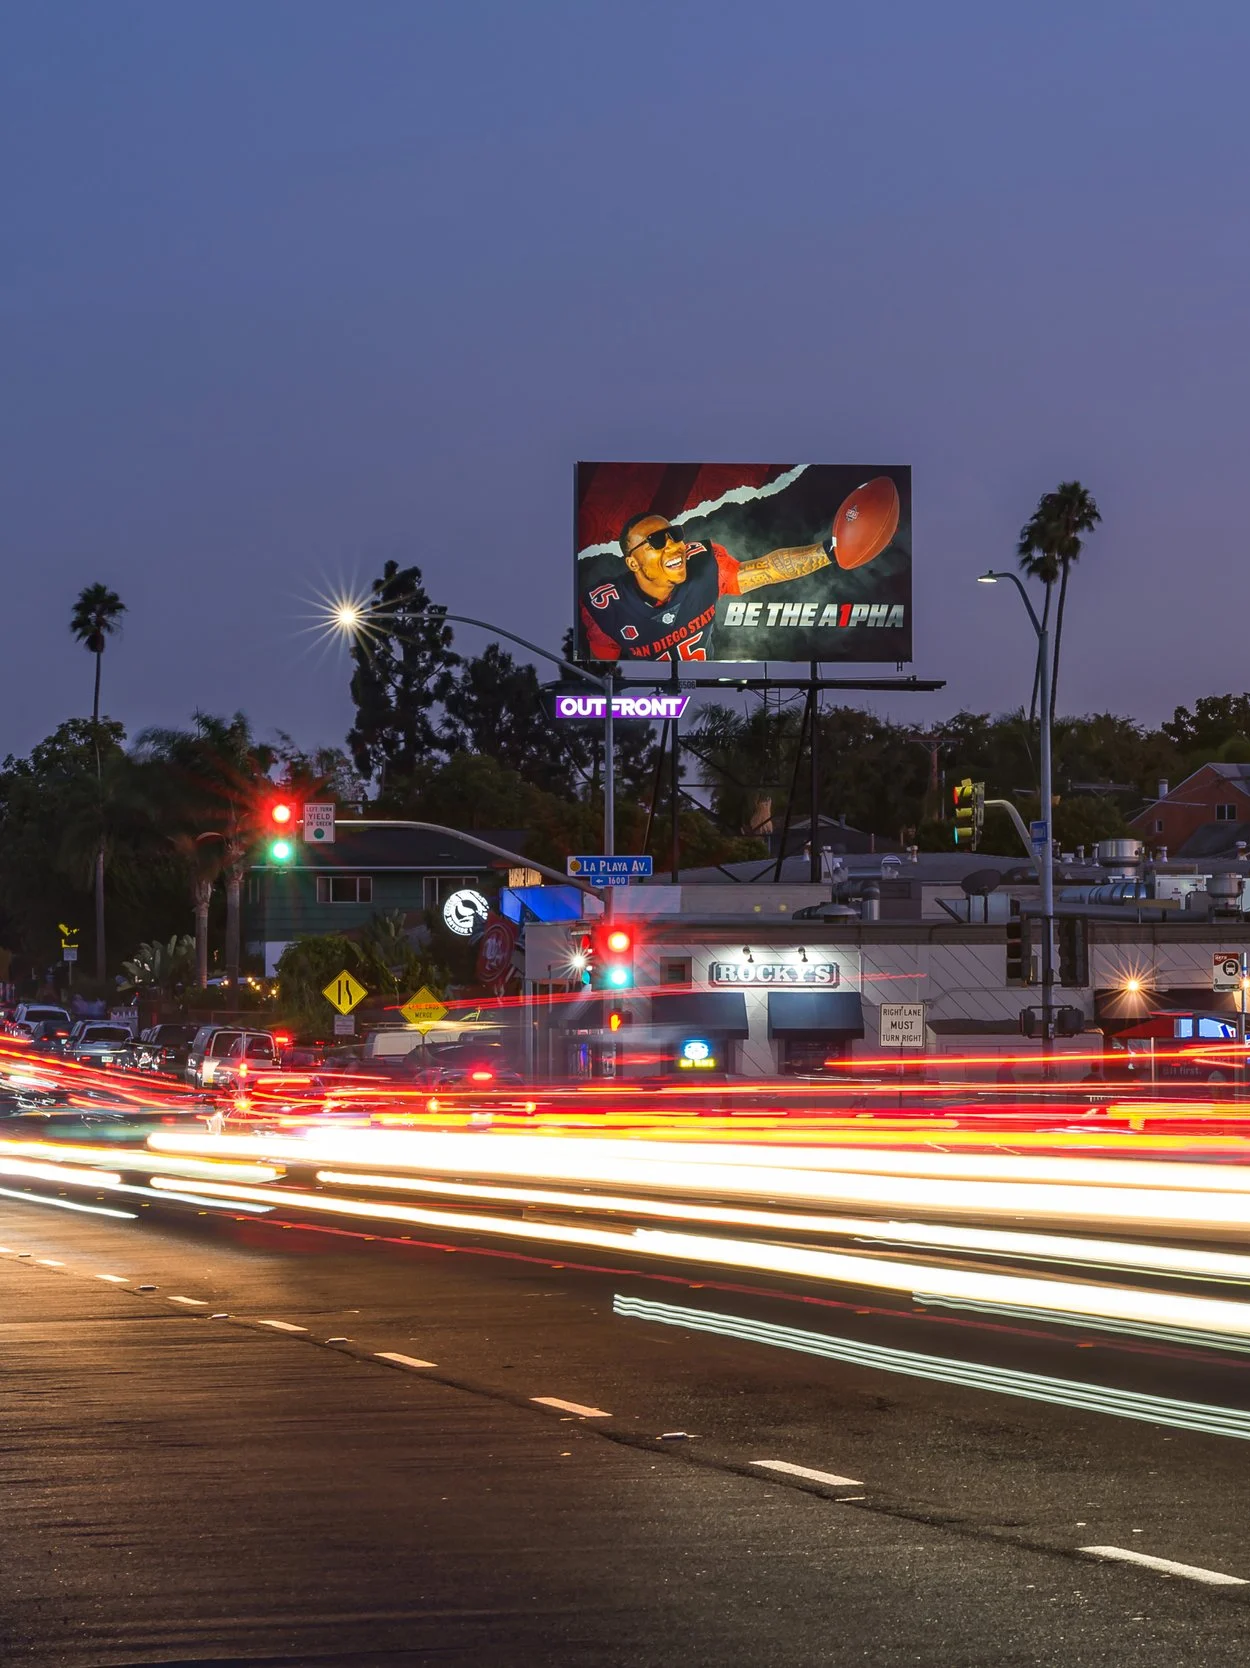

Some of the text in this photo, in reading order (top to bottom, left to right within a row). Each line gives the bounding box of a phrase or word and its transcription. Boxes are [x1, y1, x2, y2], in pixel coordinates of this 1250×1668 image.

[588, 583, 620, 610] 15
[724, 602, 905, 628] BE THE A1PHA
[652, 625, 689, 652] DIEGO
[560, 698, 682, 716] OUTFRONT
[583, 860, 648, 872] LA PLAYA AV.
[608, 877, 626, 885] 1600
[891, 1021, 913, 1029] MUST
[902, 1034, 921, 1042] RIGHT
